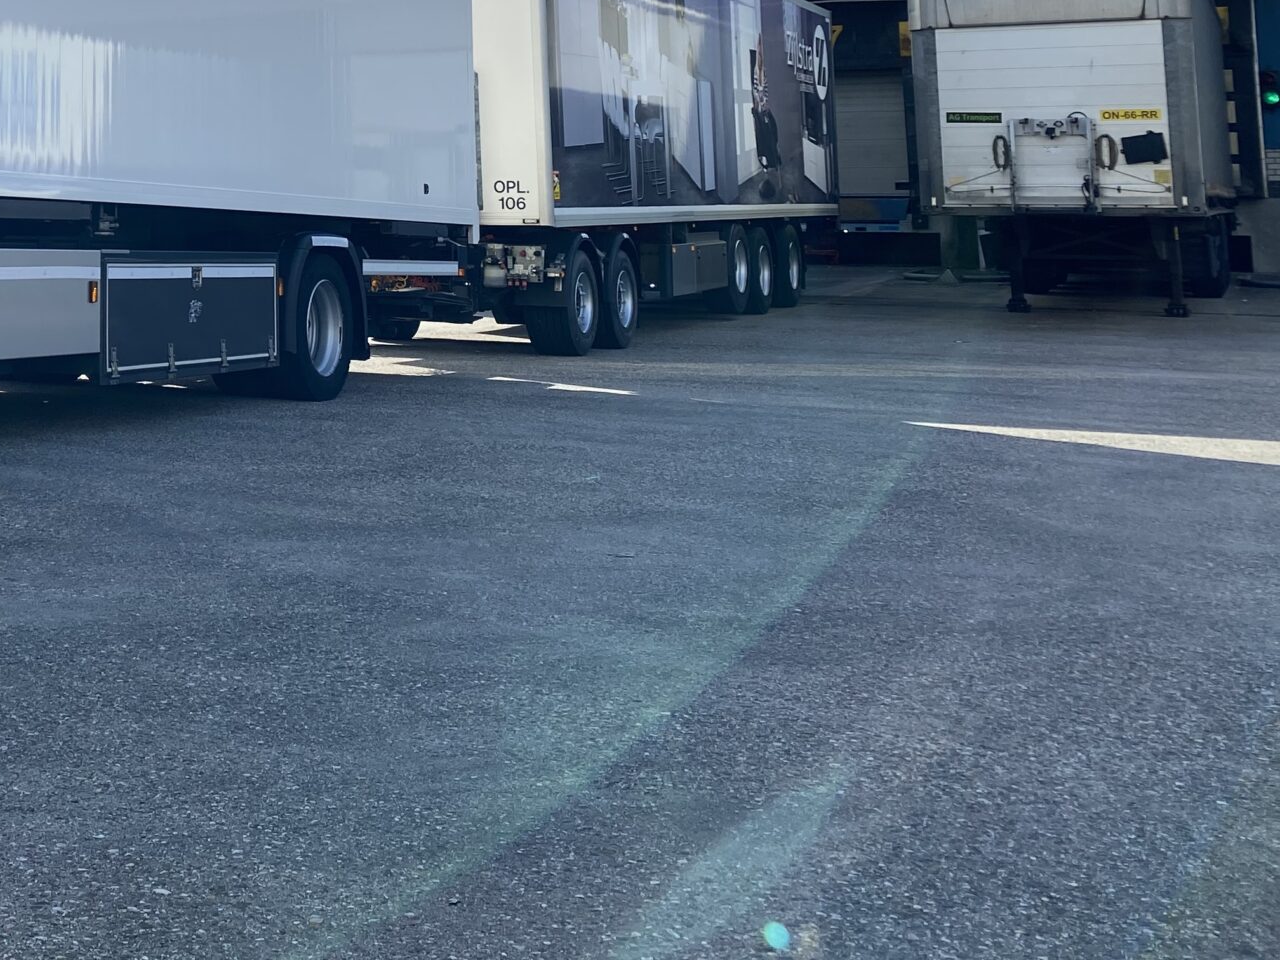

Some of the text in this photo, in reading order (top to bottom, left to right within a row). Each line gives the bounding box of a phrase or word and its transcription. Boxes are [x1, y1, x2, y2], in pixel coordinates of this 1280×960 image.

[961, 113, 1000, 122] Transport
[1102, 110, 1159, 120] ON-66-RR
[493, 180, 530, 194] OPL.
[498, 196, 527, 210] 106
